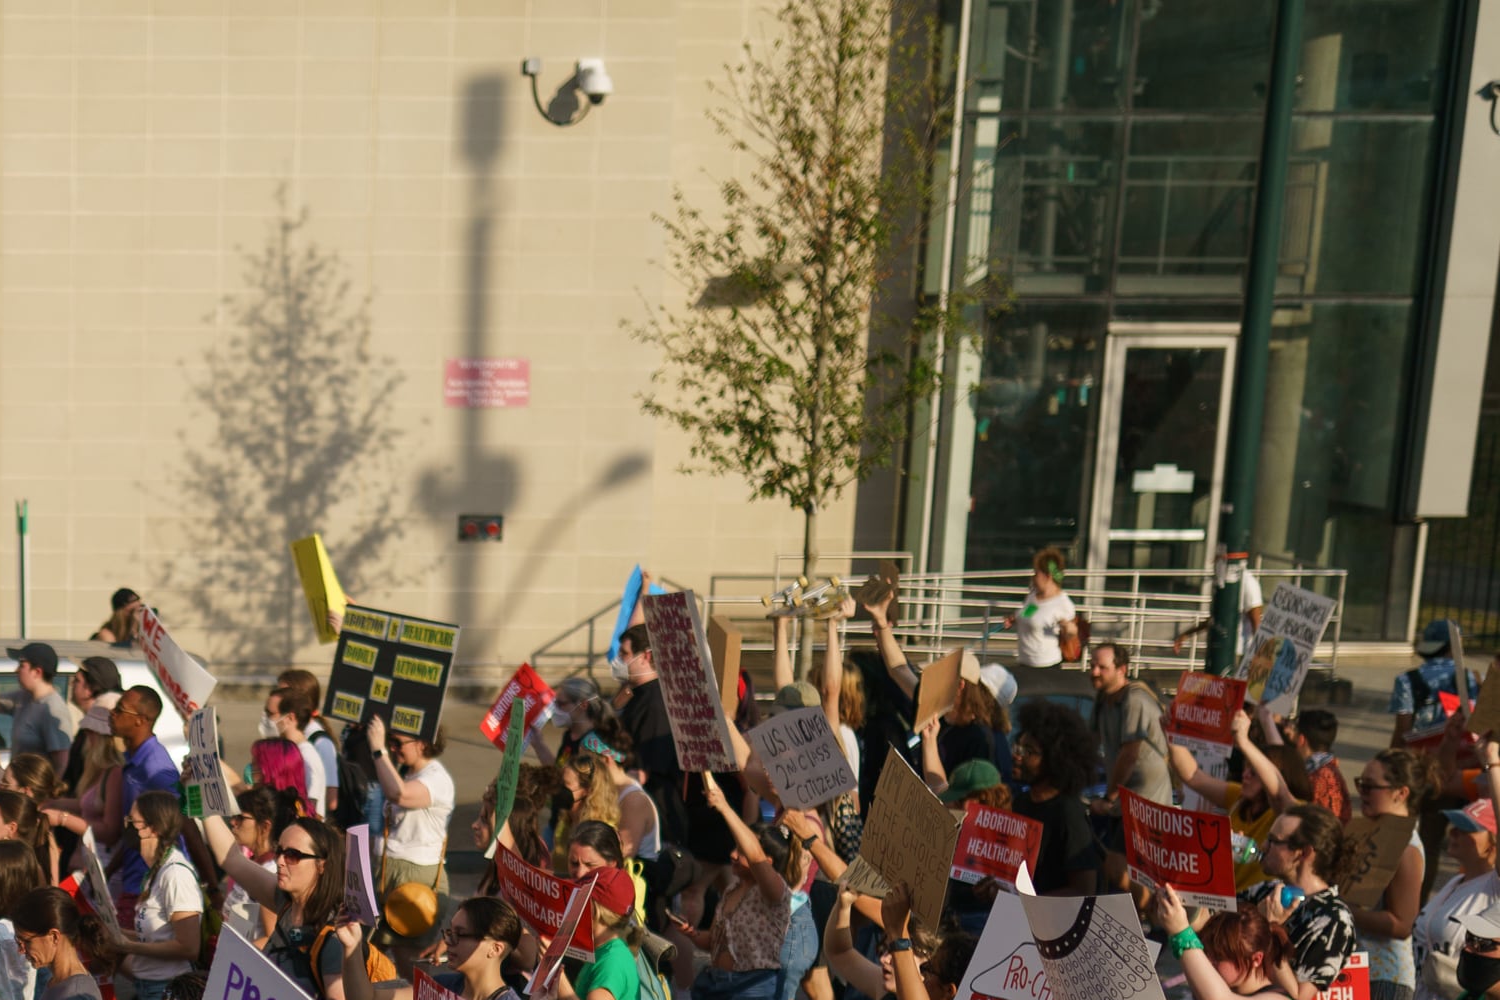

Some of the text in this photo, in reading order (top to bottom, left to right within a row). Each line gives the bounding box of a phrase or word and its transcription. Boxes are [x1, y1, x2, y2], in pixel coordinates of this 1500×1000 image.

[784, 714, 829, 748] WOMEN
[1175, 703, 1222, 728] HEALTHCARE
[796, 767, 848, 805] CITIZENS
[974, 809, 1028, 840] ABORTIONS
[1129, 796, 1194, 838] ABORTIONS
[865, 819, 904, 872] SHOULD
[902, 826, 949, 885] CHOICE
[966, 837, 1025, 867] HEALTHCARE
[1132, 831, 1199, 875] HEALTHCARE
[501, 849, 560, 900] ABORTIONS
[504, 876, 564, 929] HEALTHCARE
